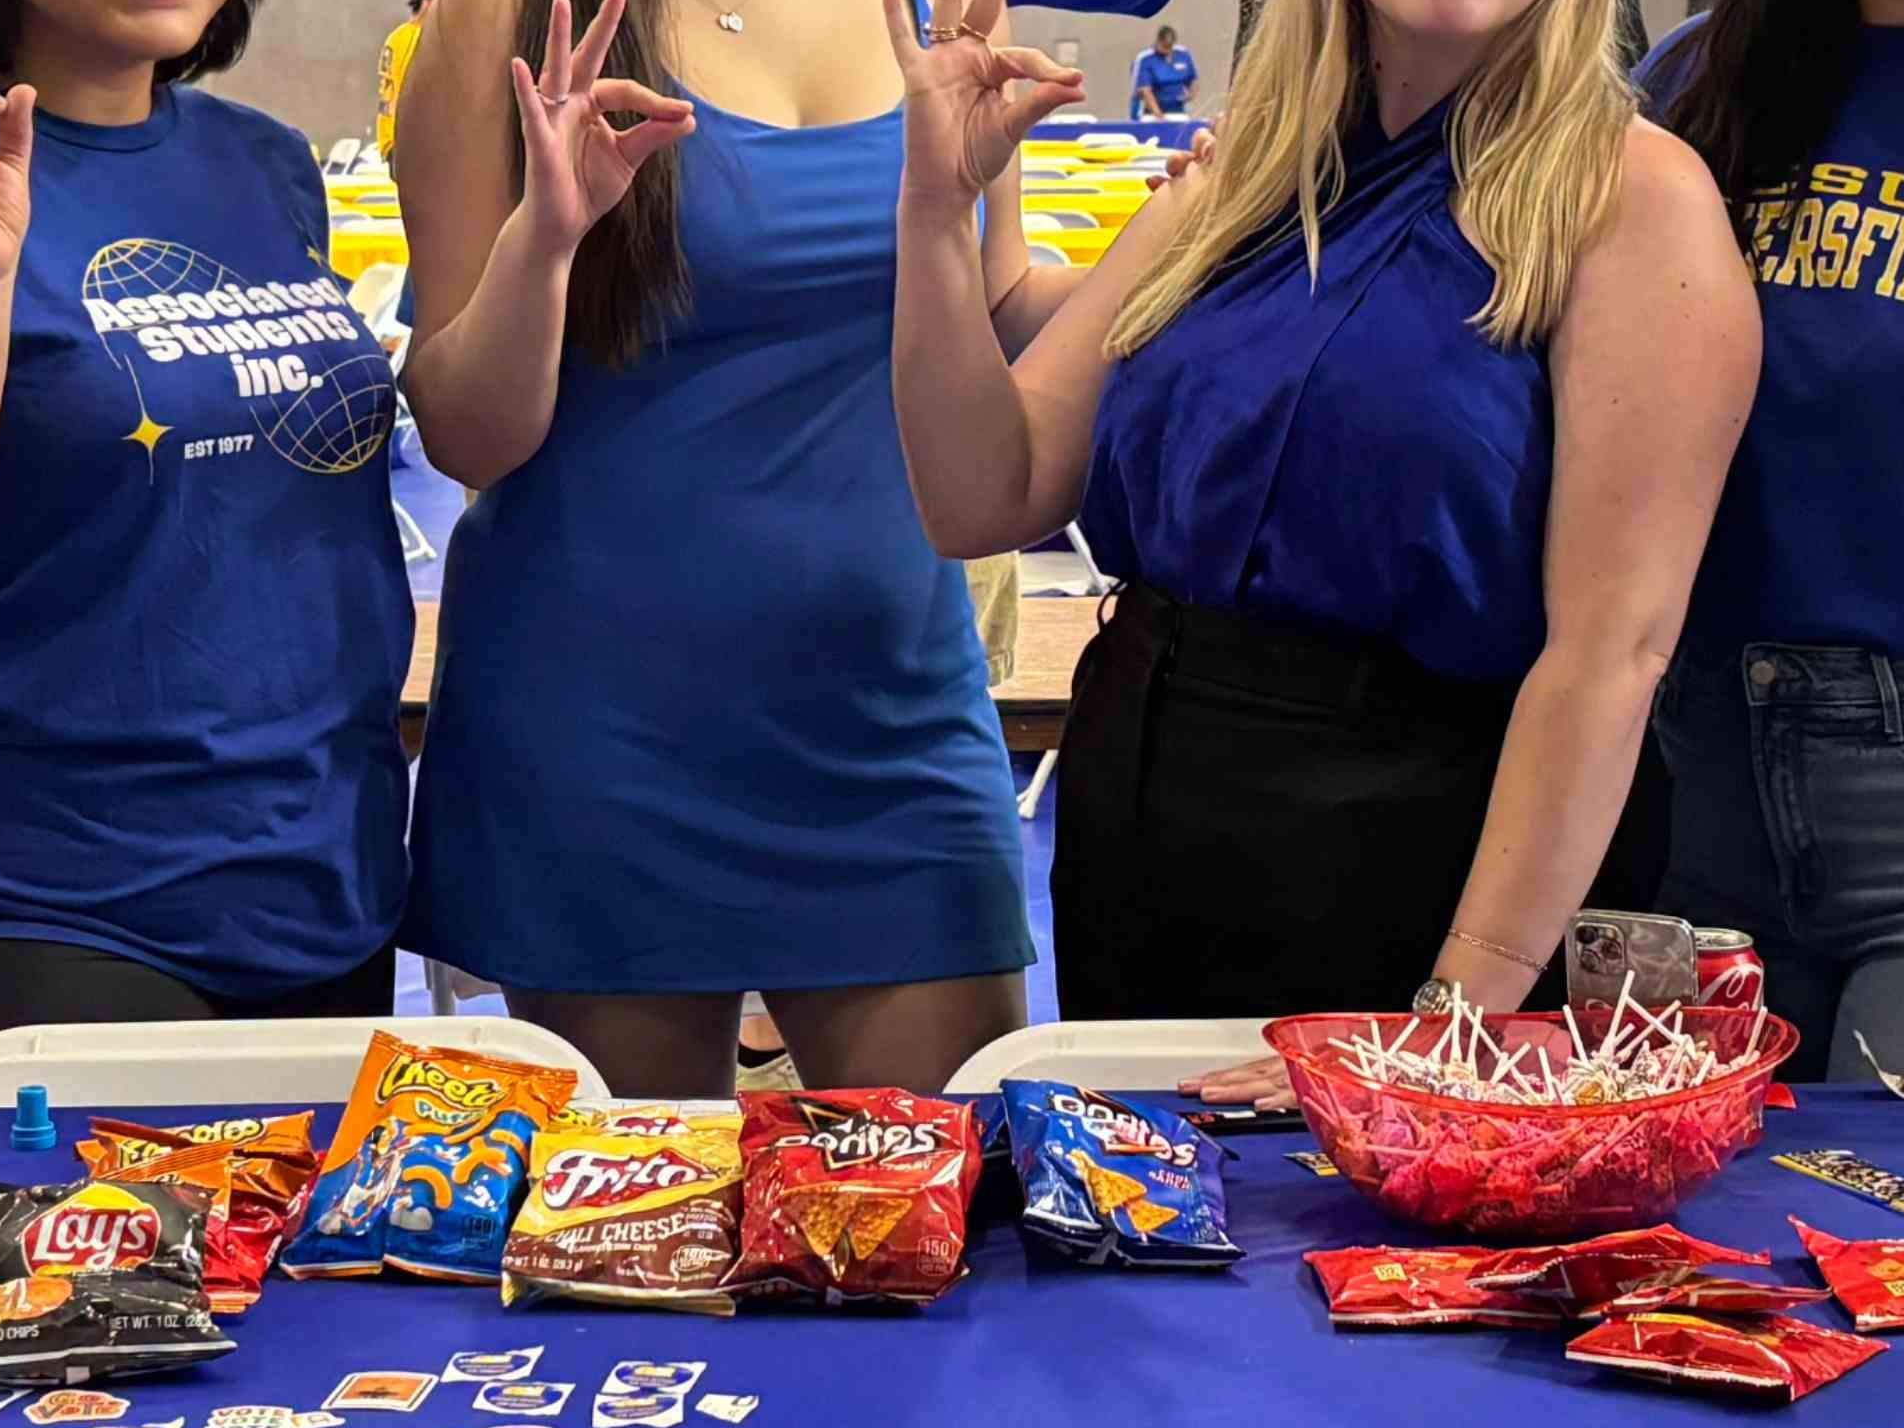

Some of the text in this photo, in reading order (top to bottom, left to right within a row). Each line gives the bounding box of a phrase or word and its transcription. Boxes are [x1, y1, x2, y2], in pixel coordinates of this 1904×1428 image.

[82, 277, 346, 333] Associated
[136, 308, 359, 363] Students
[184, 434, 254, 460] EST 1977
[774, 1120, 935, 1159] Doritos
[1051, 1093, 1197, 1167] Doritos
[600, 1213, 686, 1243] CHEESE
[6, 1324, 39, 1341] CHIPS
[215, 1408, 287, 1418] VOTE
